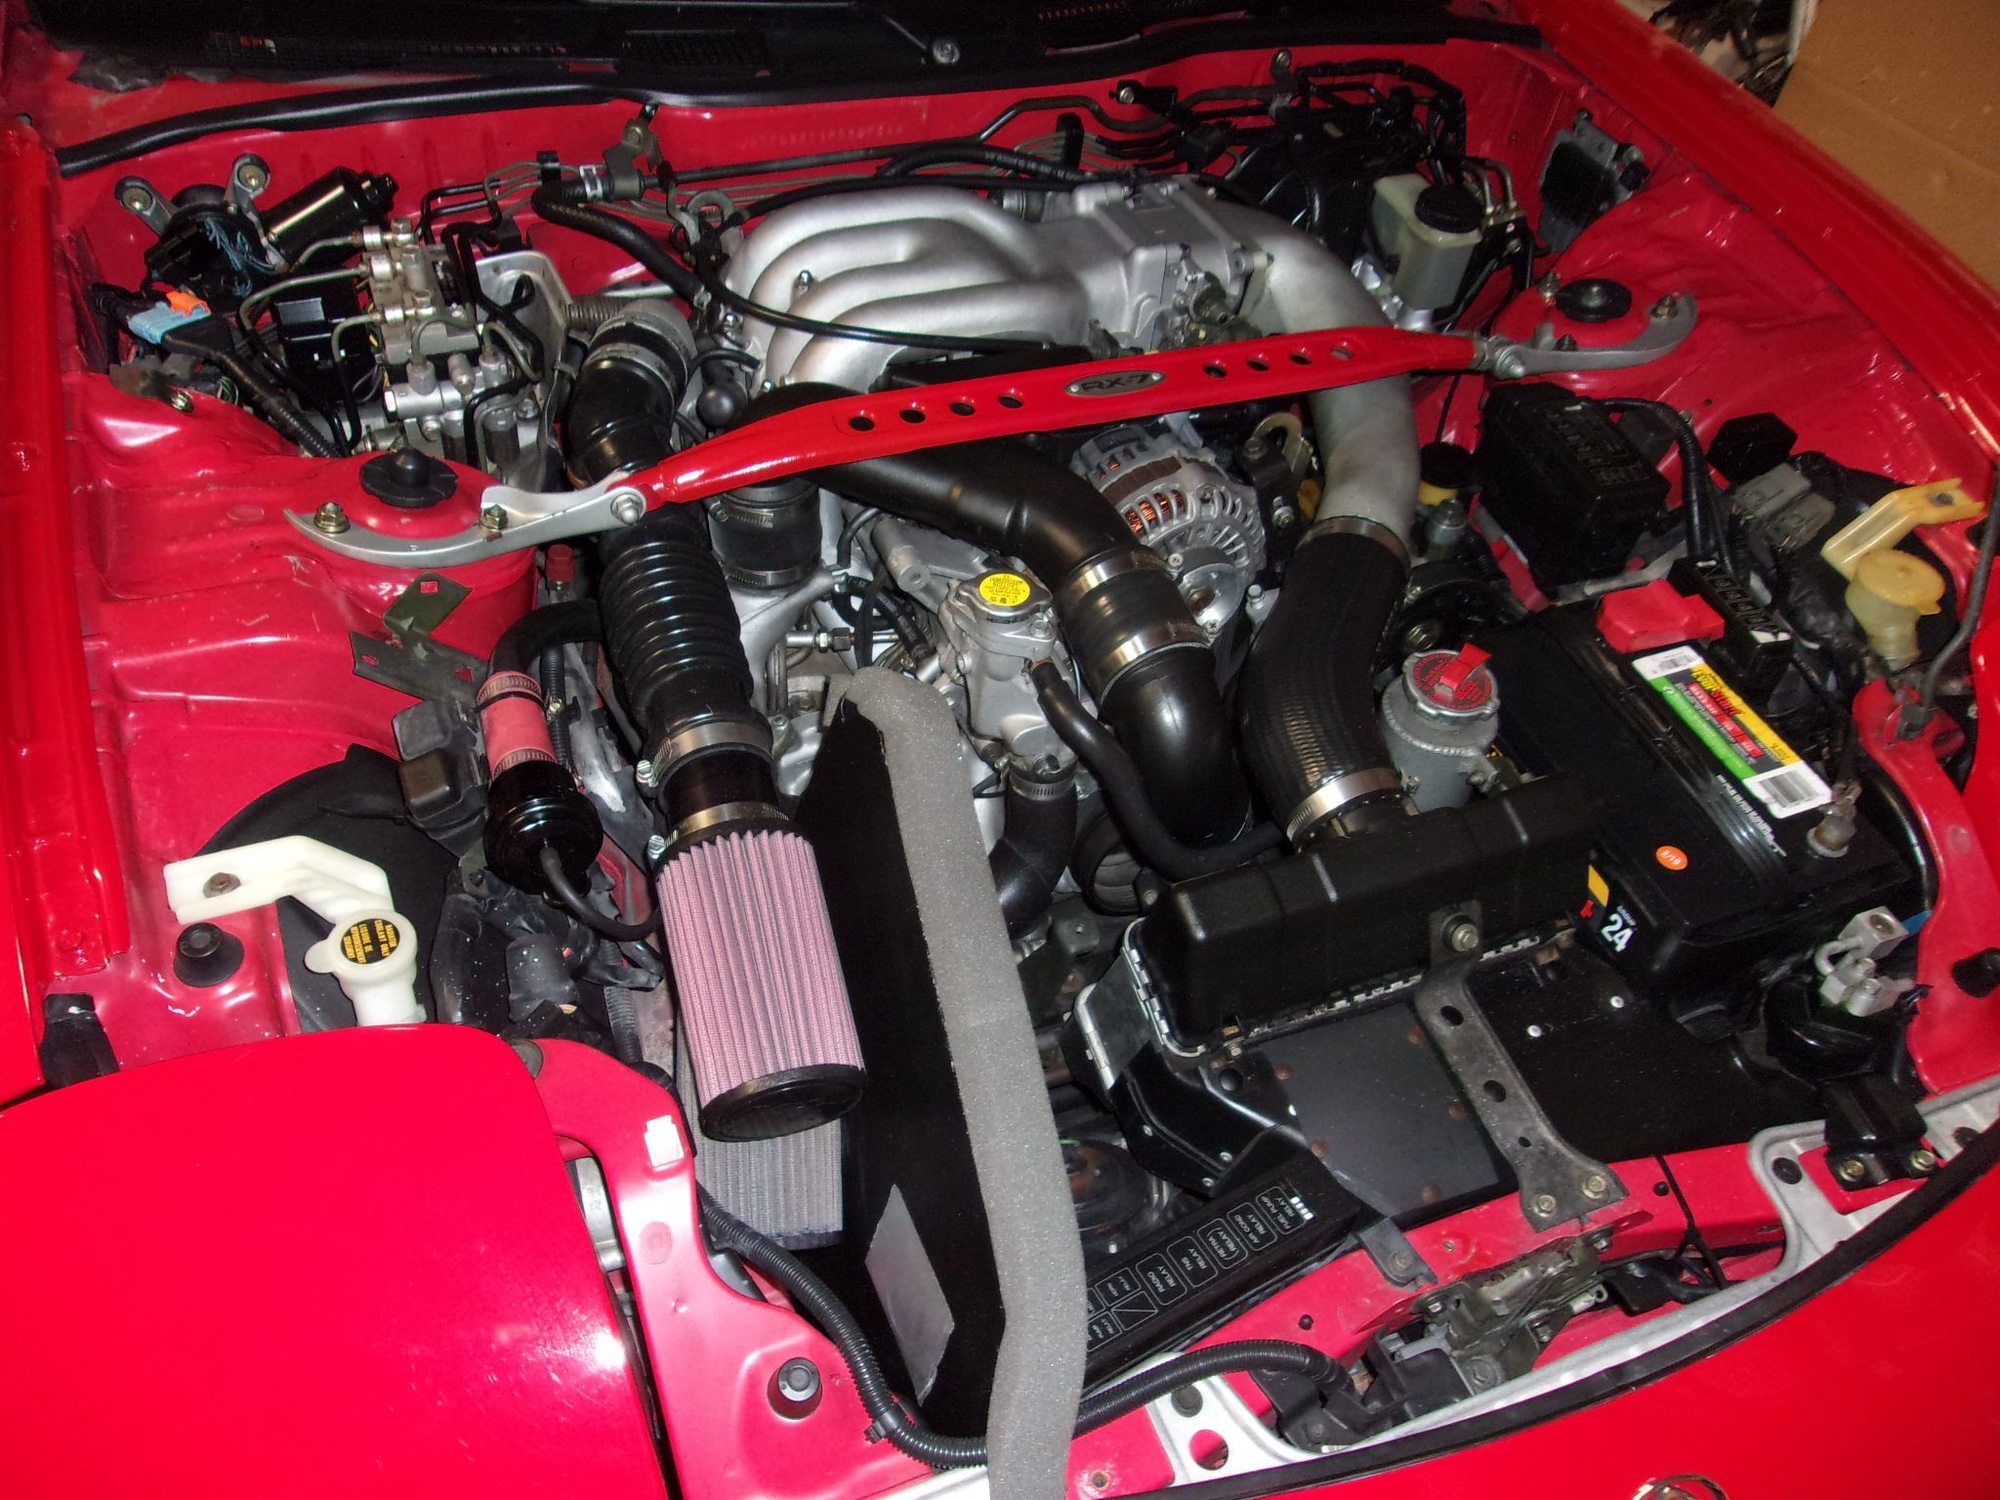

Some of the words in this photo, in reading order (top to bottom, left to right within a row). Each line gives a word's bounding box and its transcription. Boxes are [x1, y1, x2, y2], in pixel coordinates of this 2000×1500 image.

[1080, 373, 1150, 392] RX-7
[1601, 913, 1633, 953] 24
[1261, 1196, 1278, 1214] PUMP
[1275, 1198, 1295, 1217] RELAY
[1234, 1215, 1250, 1232] COND
[1248, 1215, 1266, 1234] RELAY
[1277, 1213, 1291, 1229] FUEL
[1248, 1233, 1260, 1243] AIR
[1181, 1257, 1194, 1270] TNS
[1189, 1249, 1207, 1269] RELAY
[1148, 1271, 1166, 1293] RADIO
[1157, 1266, 1176, 1287] RELAY
[1101, 1319, 1114, 1334] RELAY
